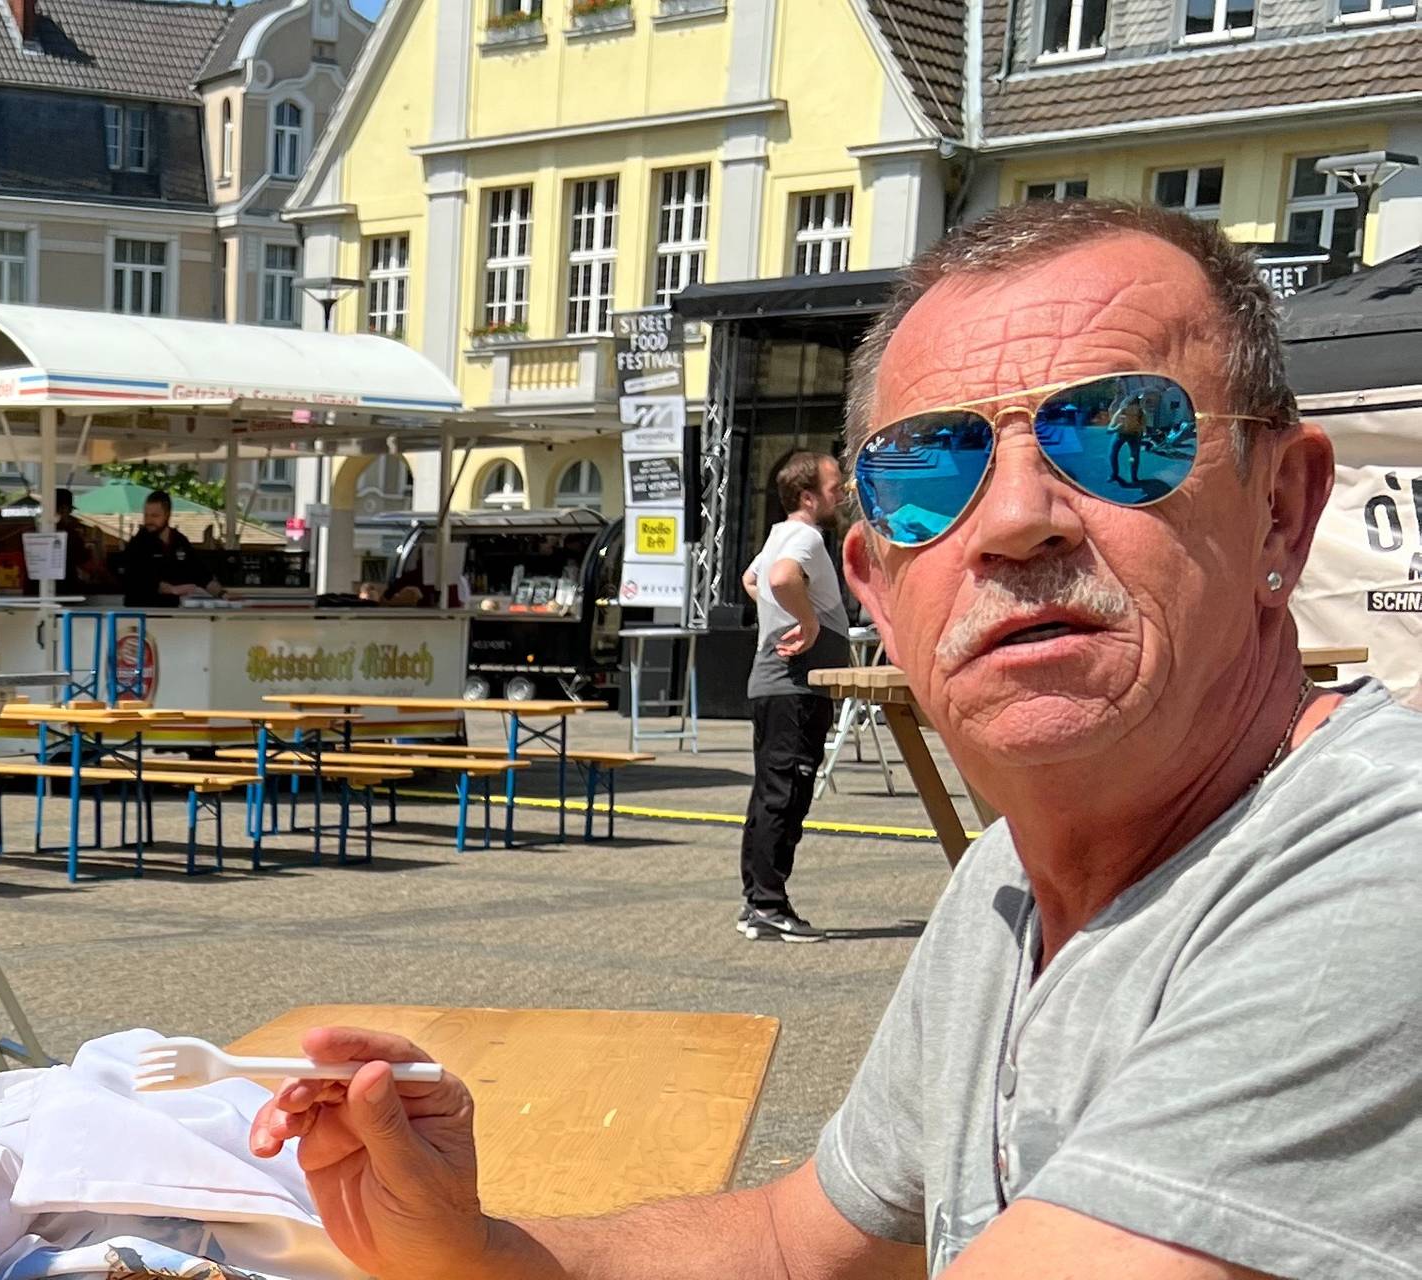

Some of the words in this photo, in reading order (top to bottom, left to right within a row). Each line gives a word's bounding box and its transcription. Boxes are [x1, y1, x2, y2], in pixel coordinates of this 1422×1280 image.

[1259, 266, 1308, 288] REET
[619, 313, 673, 333] STREET
[630, 332, 668, 351] FOOD
[617, 351, 682, 370] FESTIVAL
[1372, 592, 1422, 611] SCHN
[246, 645, 355, 683] Reissdorf
[359, 641, 435, 687] Kölsch
